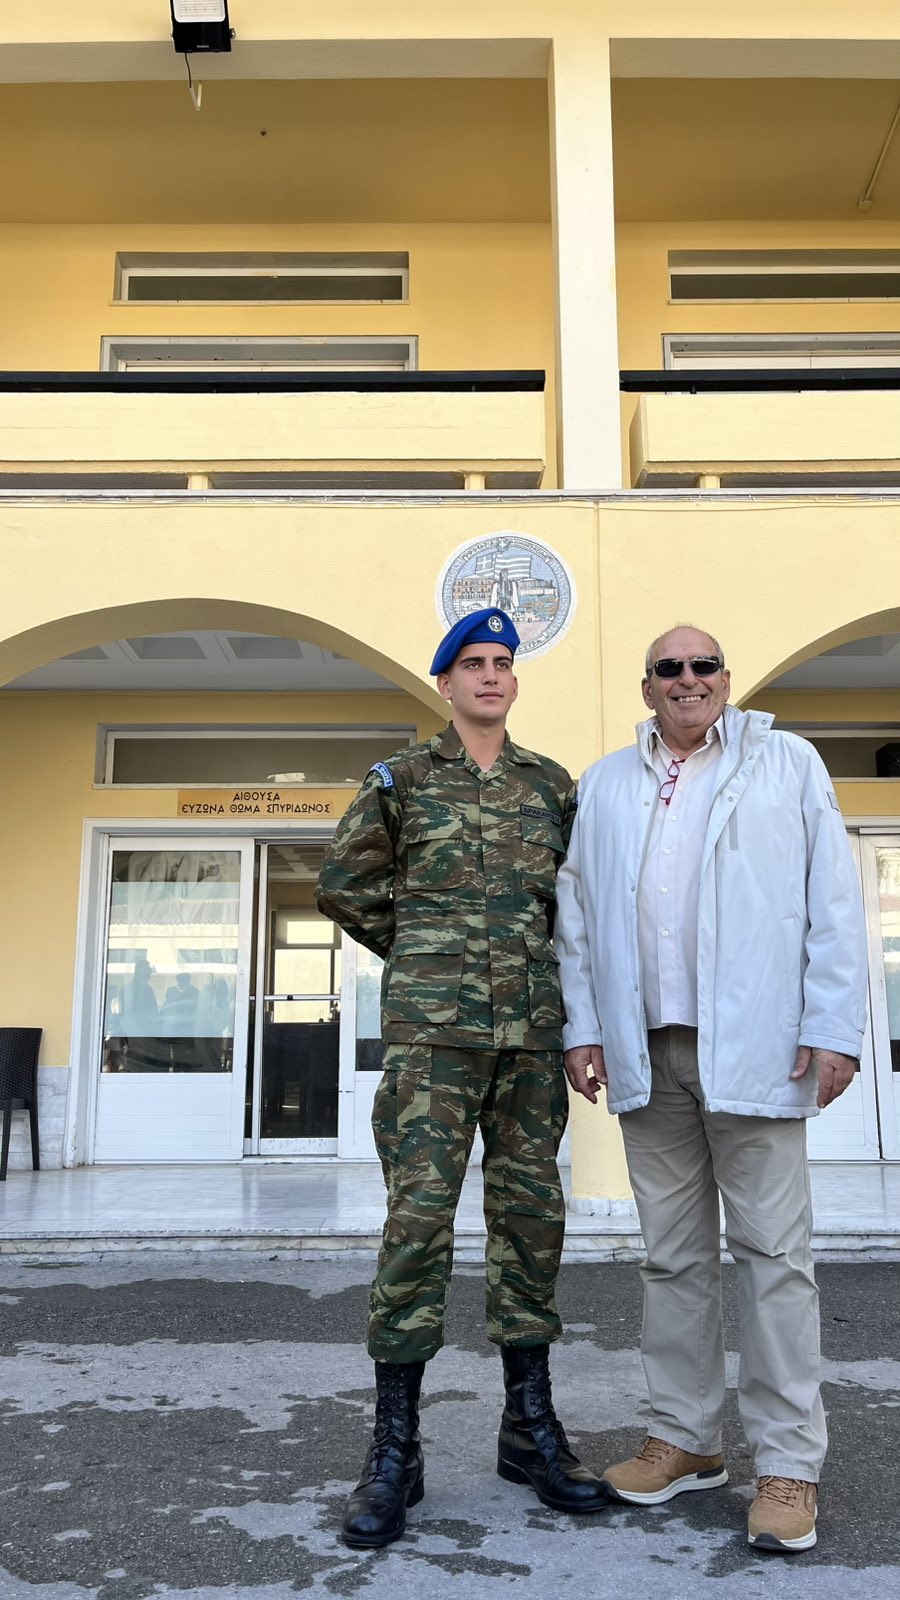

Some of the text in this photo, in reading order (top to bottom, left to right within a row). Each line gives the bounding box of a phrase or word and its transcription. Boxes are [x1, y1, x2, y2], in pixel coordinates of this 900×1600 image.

[233, 792, 280, 801] ΑΙΘΟΥΣΑ
[181, 804, 331, 814] ΕΥΖΩΝΑ ΘΩΜΑ ΣΠΥΡΙΔΩΝΟΣ
